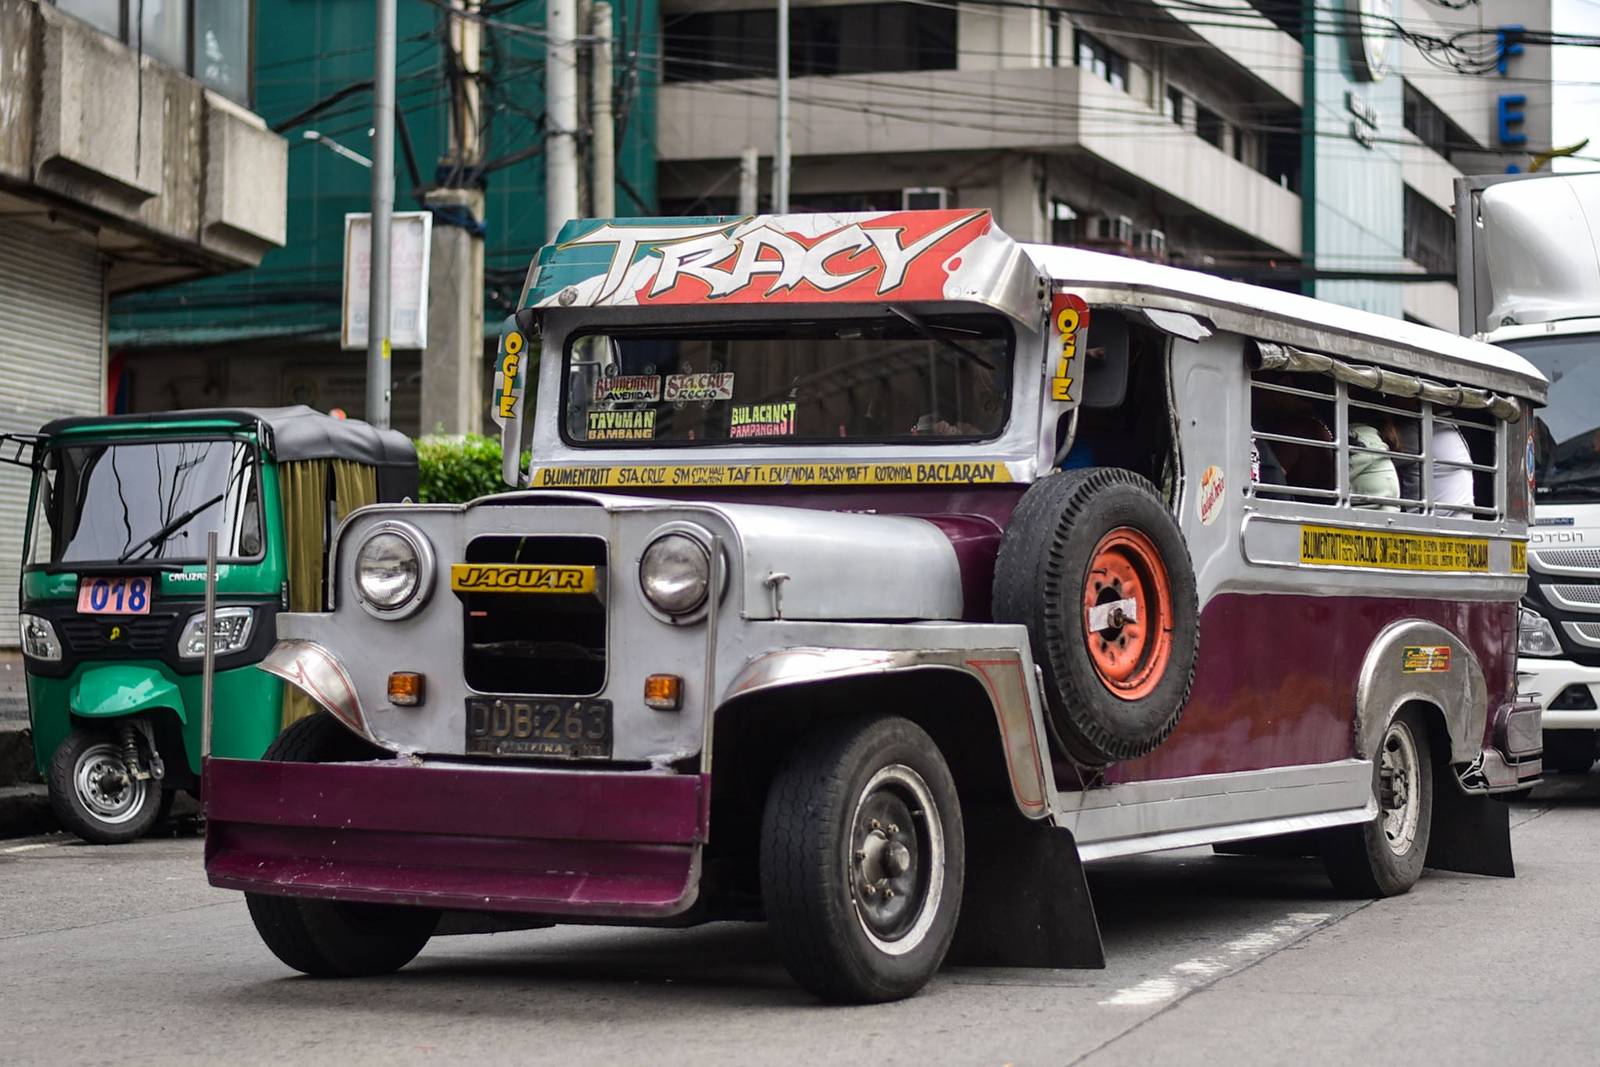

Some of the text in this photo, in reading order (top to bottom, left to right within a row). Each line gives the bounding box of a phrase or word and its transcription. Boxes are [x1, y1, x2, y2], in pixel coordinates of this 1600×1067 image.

[558, 210, 989, 305] TRACY
[1051, 308, 1080, 401] OGIE
[500, 331, 523, 418] OGIE
[604, 390, 653, 400] AVENIDA
[589, 411, 655, 430] TAYUMAN
[731, 403, 780, 426] BULACAN
[588, 428, 653, 440] BAMBANG
[730, 422, 780, 439] PAMPANGA
[543, 467, 612, 486] BLUMENTRITT
[672, 466, 690, 484] SM
[709, 466, 726, 476] HALL
[916, 463, 996, 483] BACLARAN
[458, 568, 584, 588] JAGUAR
[90, 578, 147, 612] 018
